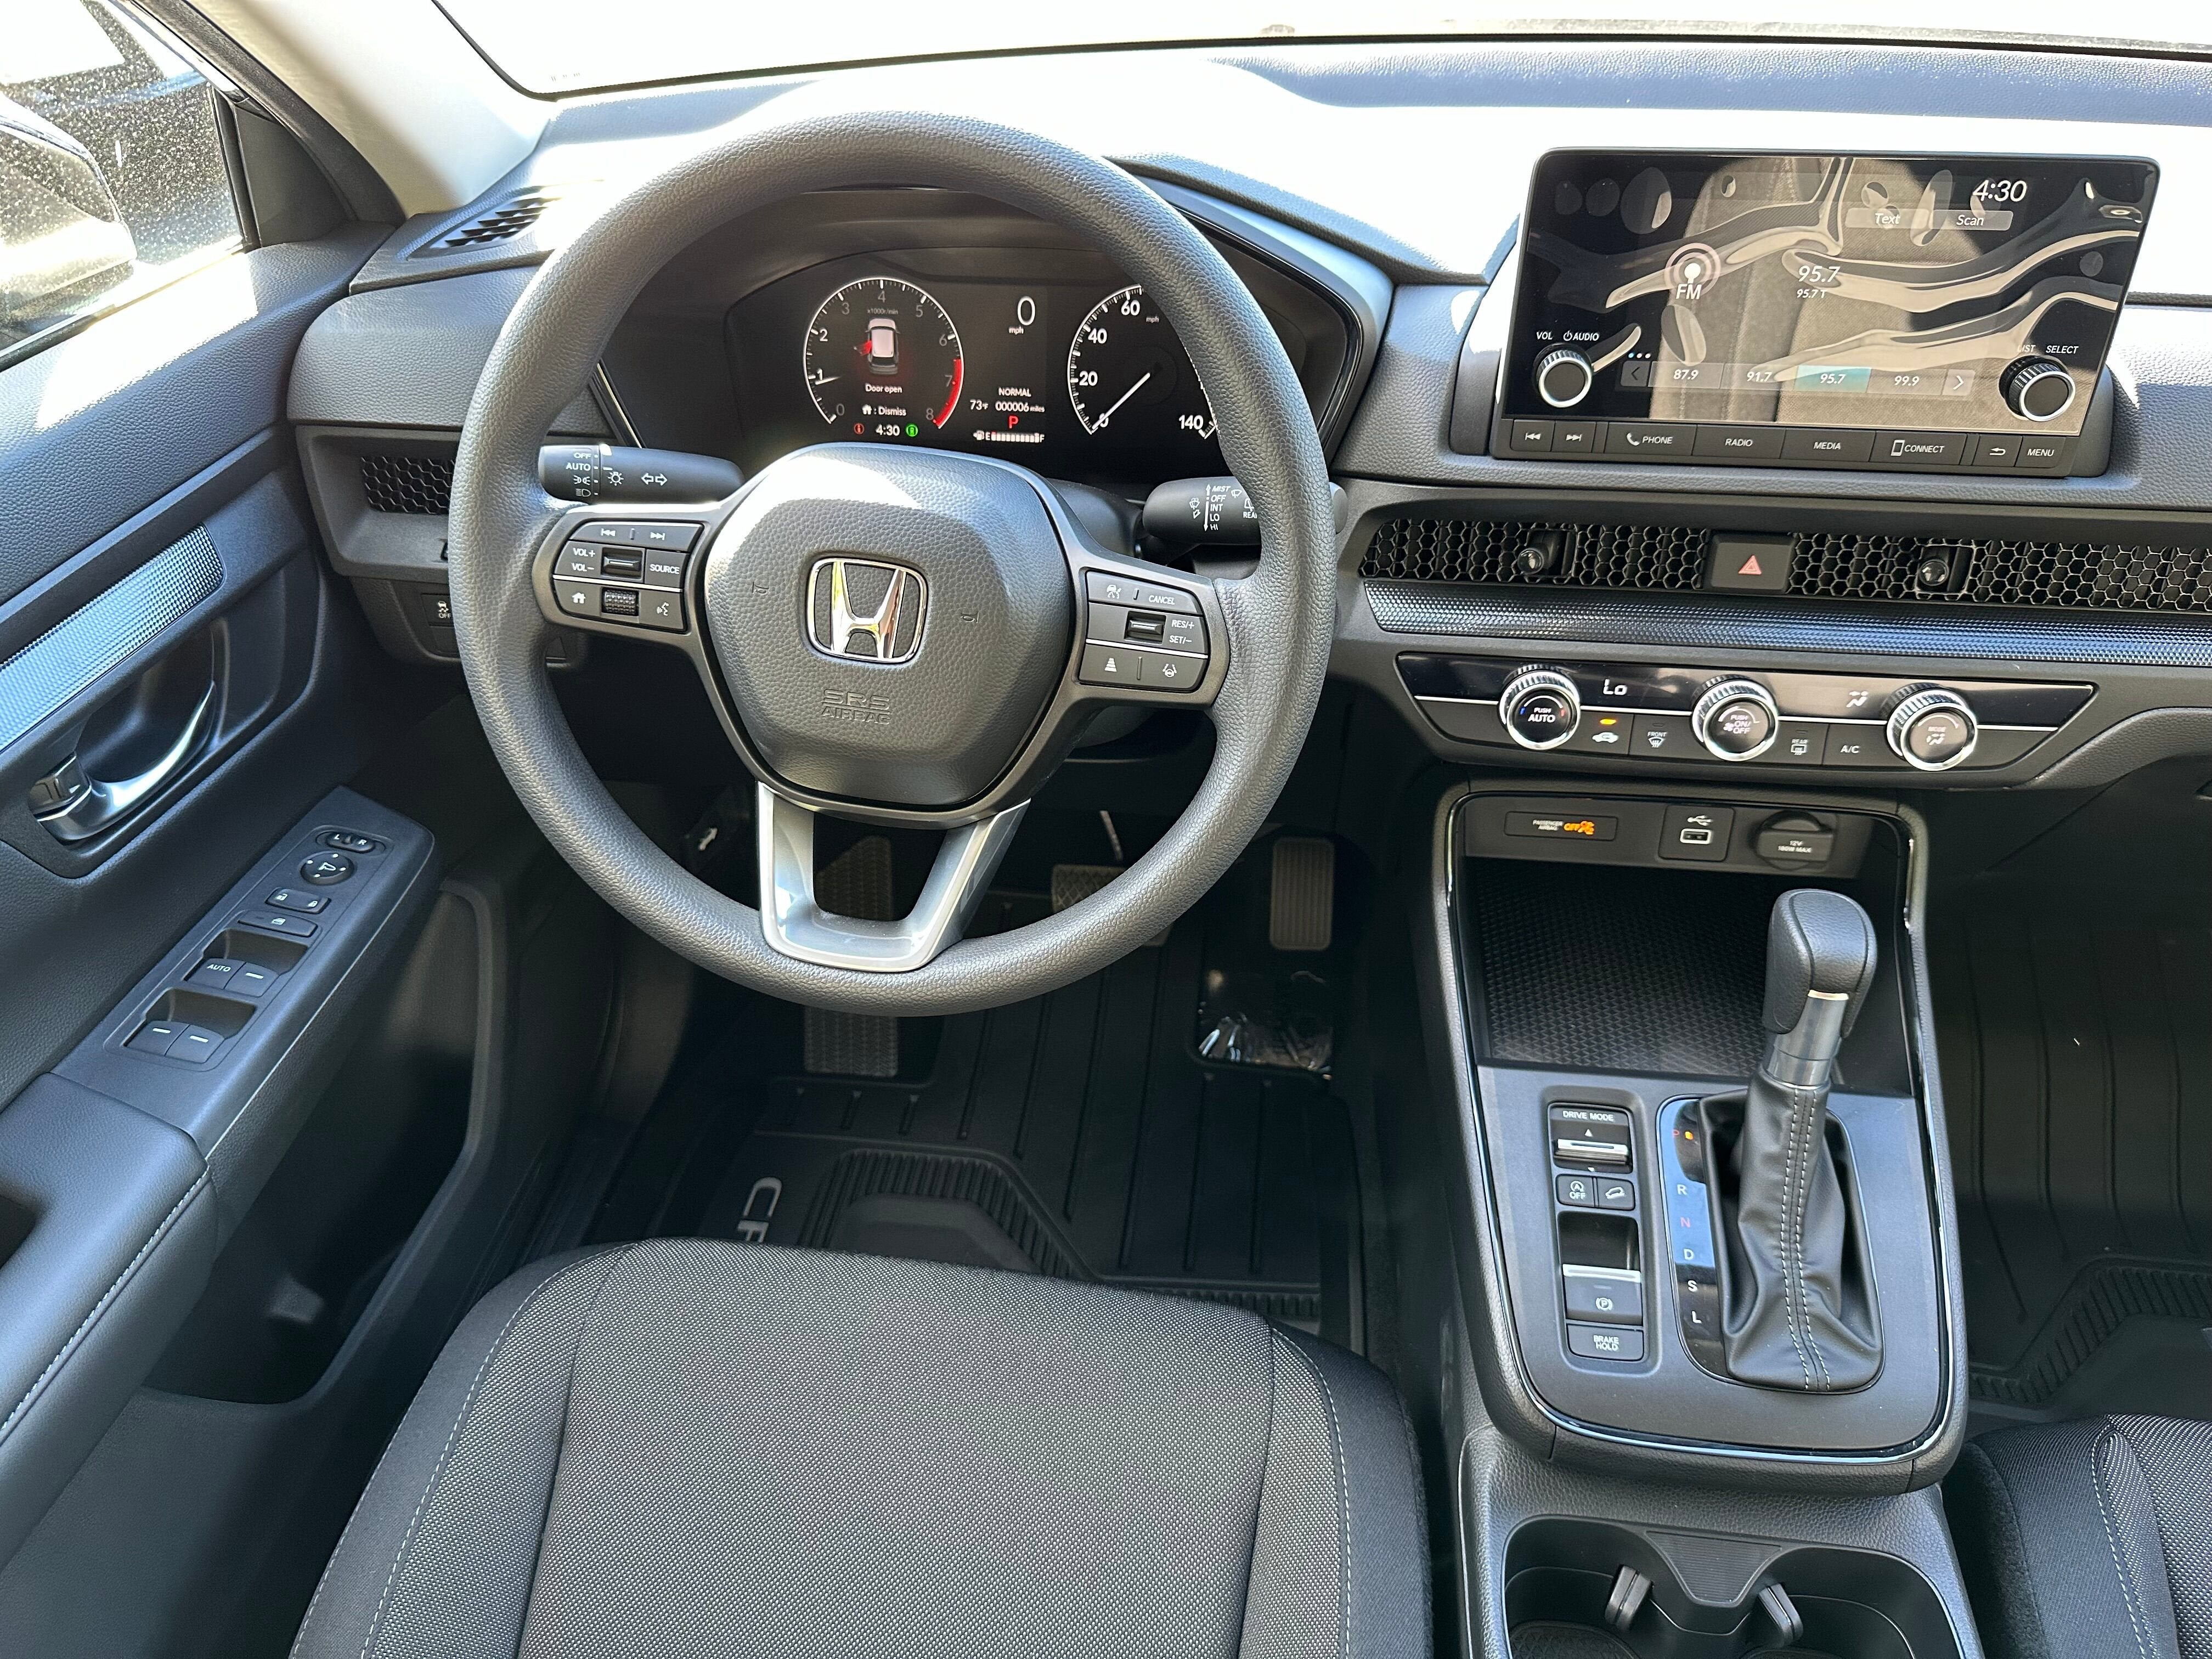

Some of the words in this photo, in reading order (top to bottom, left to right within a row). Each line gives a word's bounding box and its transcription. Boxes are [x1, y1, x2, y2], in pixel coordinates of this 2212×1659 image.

[1972, 179, 2028, 202] 4:30
[1875, 213, 1901, 224] Text
[1956, 215, 1984, 226] Scan
[1798, 266, 1841, 283] 95.7
[878, 290, 886, 303] 4
[1675, 284, 1702, 300] FM
[1796, 289, 1818, 298] 95.7
[1820, 289, 1827, 298] T
[842, 302, 850, 314] 3
[915, 305, 923, 317] 5
[1017, 295, 1036, 326] 0
[1120, 300, 1140, 316] 60
[819, 329, 828, 342] 2
[1008, 326, 1024, 335] mph
[1087, 328, 1108, 344] 40
[1536, 331, 1553, 340] VOL
[939, 334, 947, 346] 6
[1572, 332, 1599, 341] AUDIO
[2017, 345, 2036, 353] LIST
[2046, 345, 2079, 354] SELECT
[816, 368, 823, 381] 1
[1079, 371, 1098, 386] 20
[1673, 369, 1699, 380] 87.9
[1747, 371, 1773, 382] 91.7
[1820, 374, 1846, 385] 95.7
[945, 375, 952, 387] 7
[1894, 376, 1920, 386] 99.9
[865, 383, 883, 393] Door
[884, 386, 902, 394] open
[998, 387, 1032, 397] NORMAL
[836, 403, 845, 416] 0
[878, 406, 906, 416] Dismiss
[995, 400, 1030, 412] 000006
[926, 408, 934, 420] 8
[1009, 415, 1019, 429] P
[1178, 414, 1204, 430] 140
[876, 424, 900, 436] 4:30
[985, 431, 991, 441] E
[1040, 433, 1045, 443] F
[1642, 435, 1673, 445] PHONE
[1725, 438, 1753, 447] RADIO
[1813, 441, 1841, 450] MEDIA
[1904, 444, 1945, 454] CONNECT
[2027, 448, 2055, 457] MENU
[566, 463, 591, 471] AUTO
[1210, 494, 1227, 503] OFF
[1210, 503, 1223, 512] INT
[1210, 513, 1220, 522] LO
[573, 548, 596, 558] VOL+
[650, 563, 680, 574] SOURCE
[1148, 595, 1175, 605] CANCEL
[1602, 679, 1628, 695] Lo
[823, 689, 890, 710] SRS
[822, 706, 890, 725] AIRBAG
[1527, 714, 1556, 723] AUTO
[1840, 744, 1860, 754] A/C
[1562, 1110, 1589, 1120] DRIVE
[1589, 1113, 1614, 1122] MODE
[1677, 1184, 1688, 1195] R
[1569, 1191, 1586, 1200] OFF
[1680, 1217, 1691, 1228] N
[1684, 1249, 1695, 1260] D
[1688, 1279, 1698, 1293] S
[1691, 1310, 1703, 1323] L
[1593, 1334, 1620, 1345] BRAKE
[1595, 1341, 1619, 1351] HOLD
